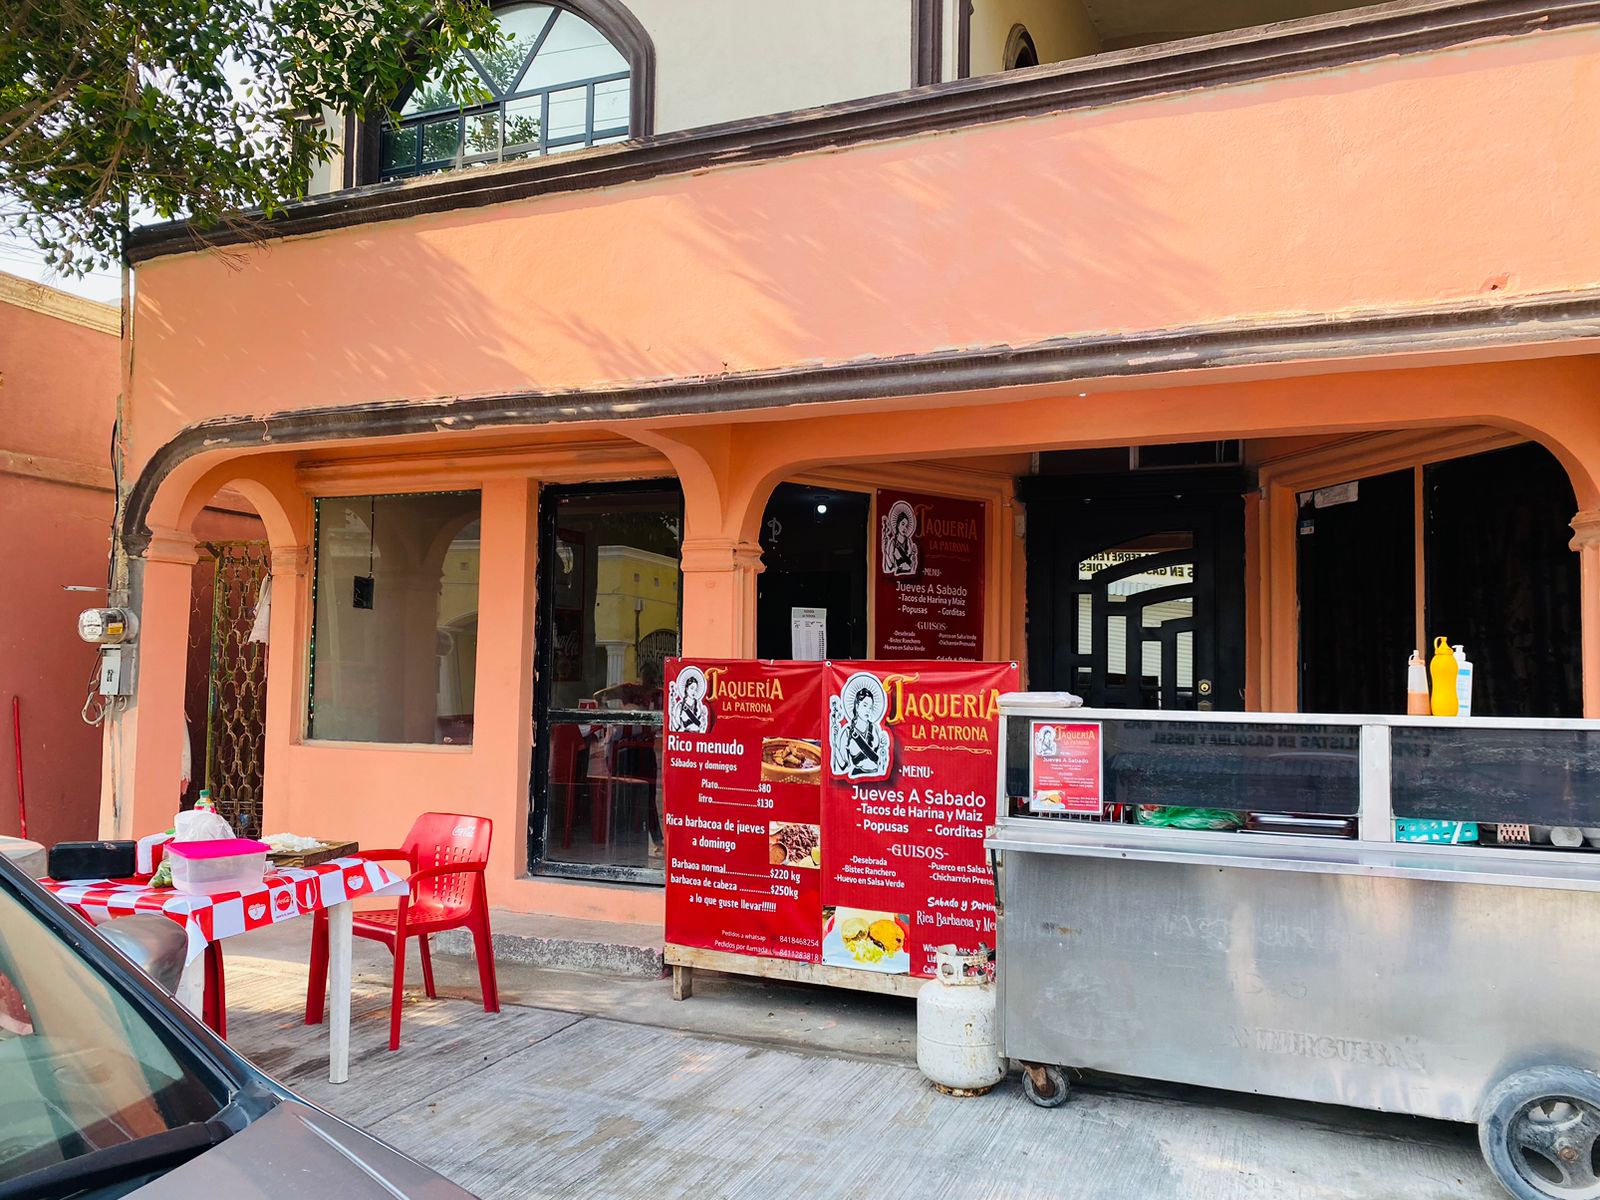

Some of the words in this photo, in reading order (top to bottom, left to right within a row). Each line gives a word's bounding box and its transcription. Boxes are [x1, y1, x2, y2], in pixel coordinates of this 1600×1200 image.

[896, 580, 925, 594] Jueves
[927, 584, 934, 594] A
[936, 584, 967, 597] Sabado
[918, 594, 926, 603] de
[926, 596, 947, 604] Harina
[902, 604, 928, 615] Popusas
[941, 607, 966, 616] Gorditas
[722, 701, 732, 711] LA
[735, 702, 772, 713] PATRONA
[912, 725, 927, 739] LA
[931, 725, 988, 741] PATRONA
[668, 735, 692, 752] Rico
[696, 739, 744, 755] menudo
[670, 758, 697, 768] Sábados
[699, 762, 703, 771] y
[704, 760, 737, 773] domingos
[851, 785, 904, 803] Jueves
[908, 788, 920, 803] A
[925, 789, 986, 808] Sabado
[892, 804, 906, 817] de
[908, 806, 944, 819] Harina
[946, 811, 953, 822] y
[955, 809, 983, 822] Maiz
[666, 813, 683, 826] Rica
[685, 815, 722, 830] barbacoa
[724, 819, 734, 831] de
[736, 820, 765, 835] jueves
[863, 819, 909, 834] Popusas
[935, 824, 983, 838] Gorditas
[692, 837, 697, 846] a
[699, 835, 736, 853] domingo
[865, 866, 896, 877] Ranchero
[967, 864, 986, 874] Salsa
[670, 872, 701, 886] barbacoa
[703, 877, 712, 887] de
[713, 879, 737, 891] cabeza
[790, 870, 800, 884] kg
[867, 877, 884, 886] Salsa
[884, 879, 905, 888] Verde
[689, 895, 694, 903] a
[695, 892, 702, 903] lo
[704, 897, 717, 907] que
[718, 899, 739, 909] guste
[960, 900, 968, 911] y
[916, 910, 934, 925] Rica
[936, 912, 974, 927] Barbacoa
[976, 920, 981, 931] y
[721, 930, 740, 938] Pedidos
[714, 940, 735, 949] Pedidos
[746, 944, 768, 953] llamada
